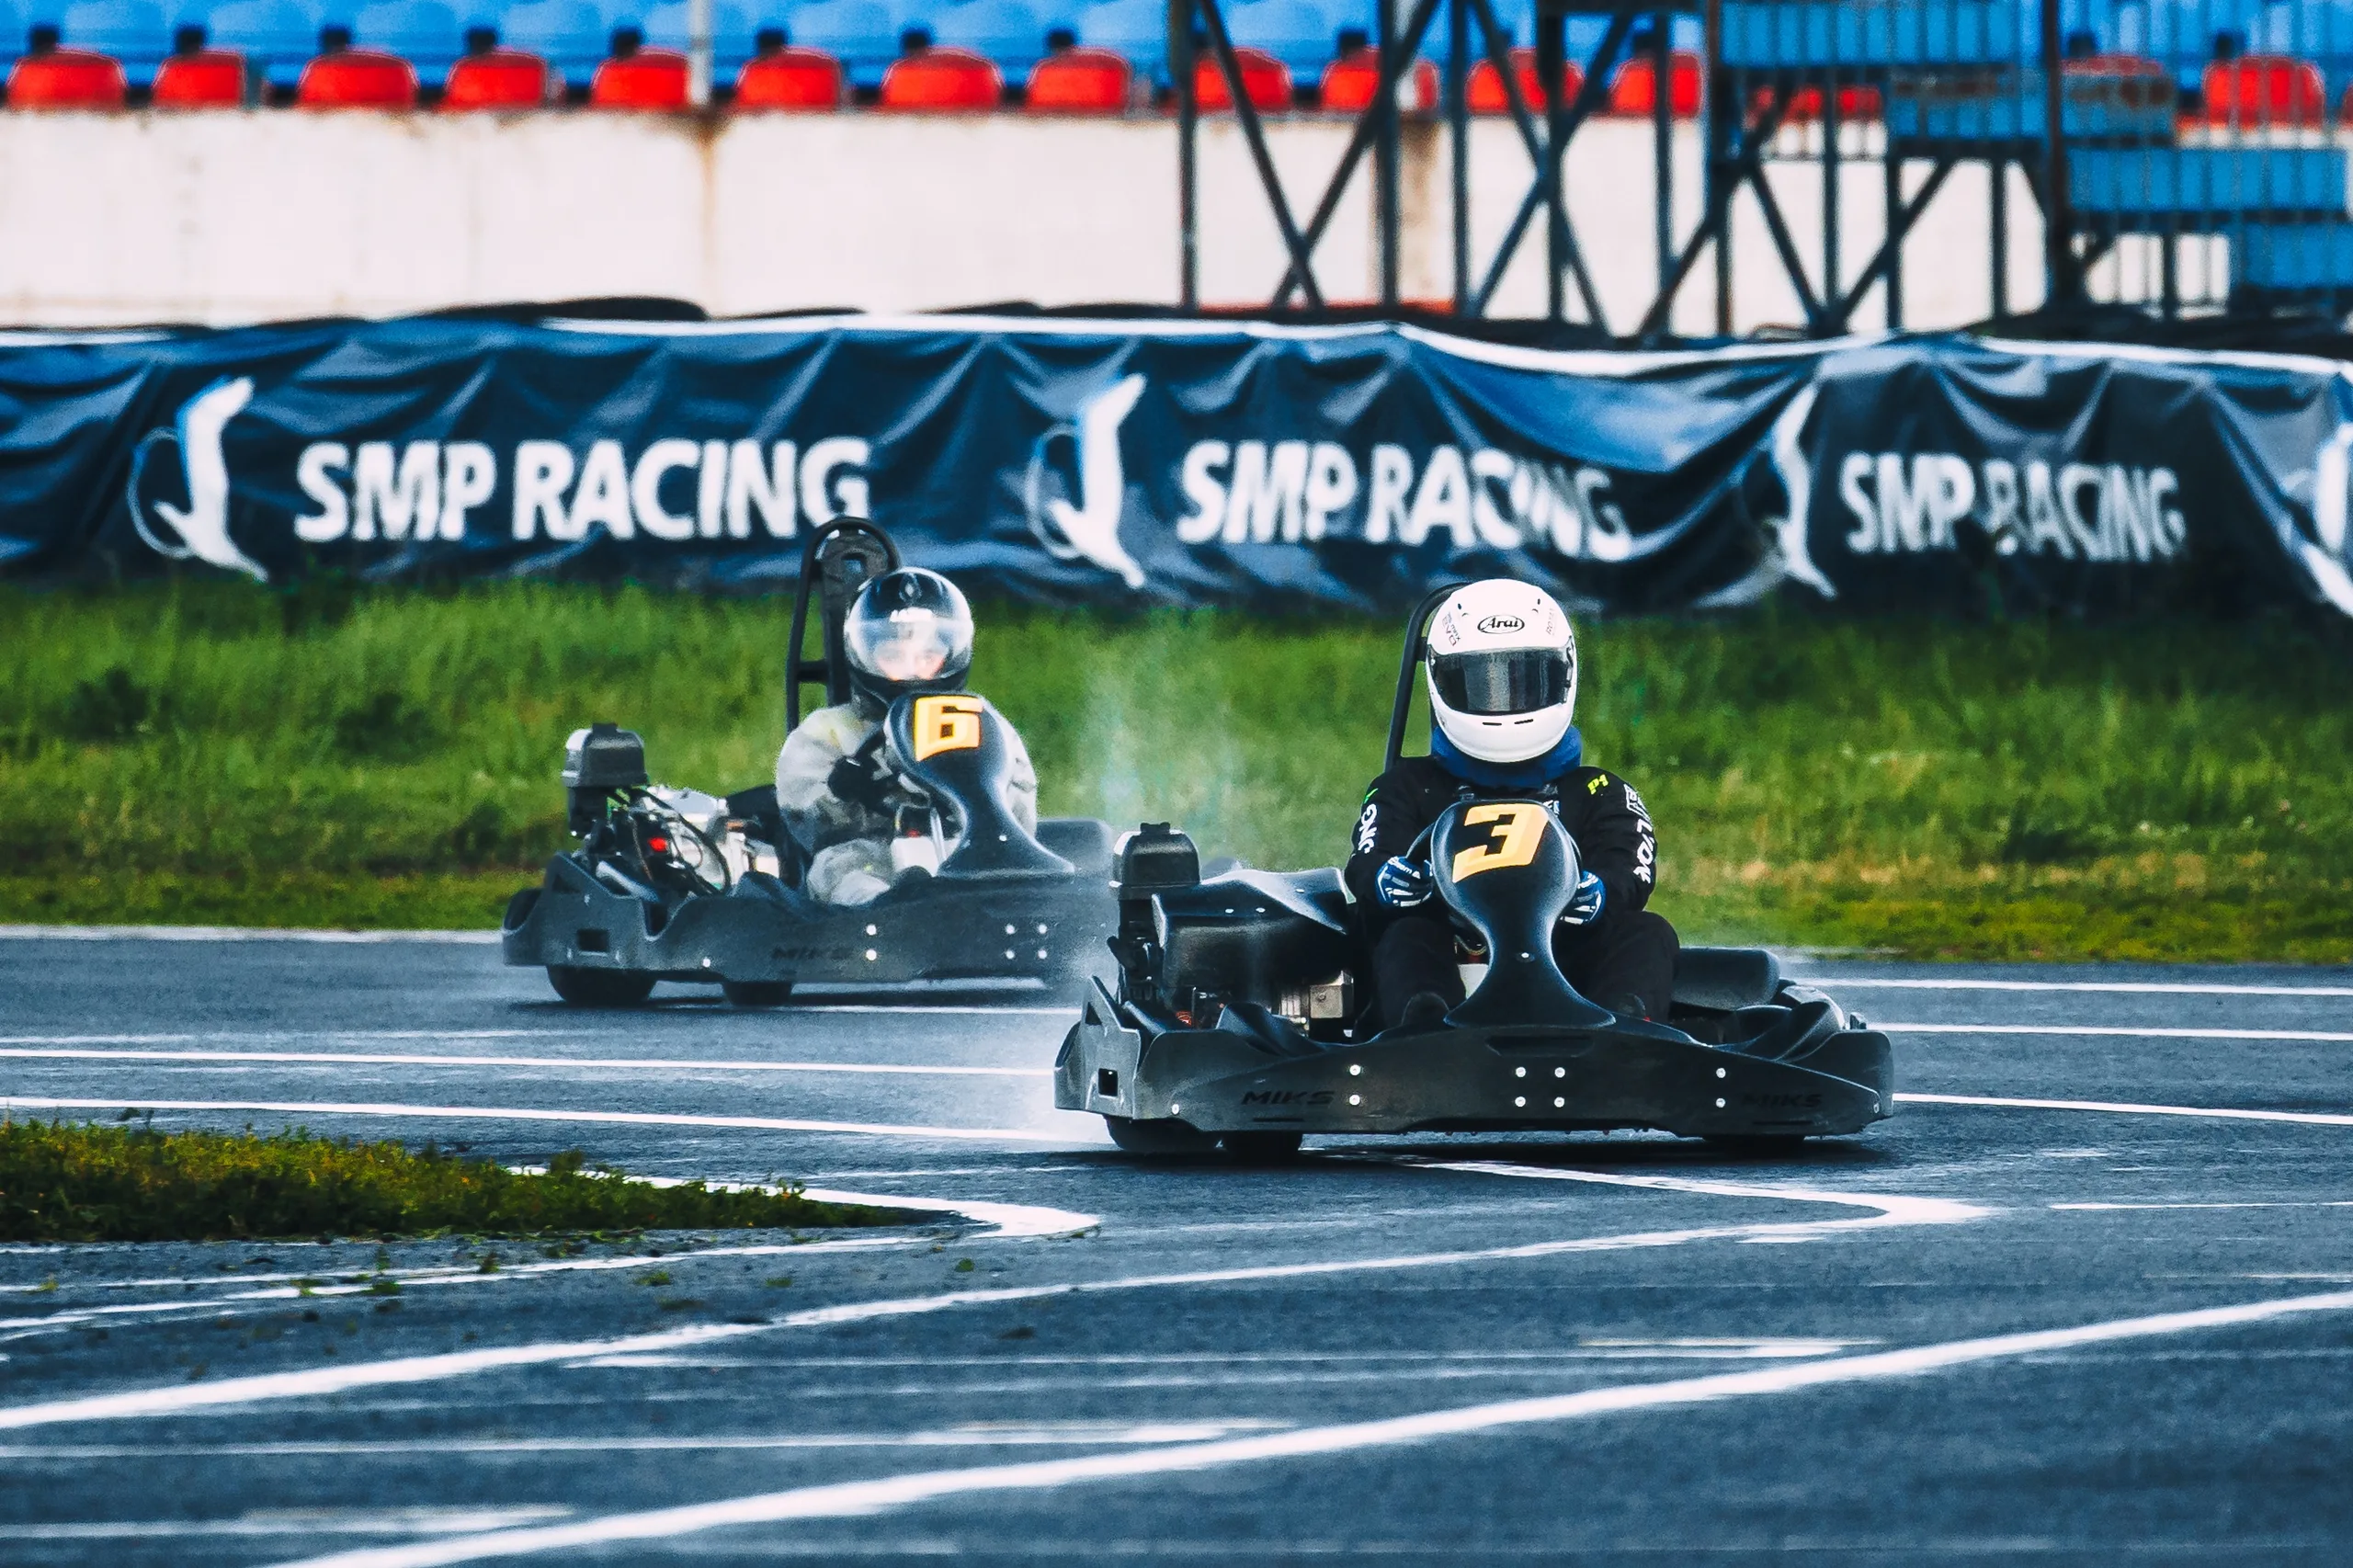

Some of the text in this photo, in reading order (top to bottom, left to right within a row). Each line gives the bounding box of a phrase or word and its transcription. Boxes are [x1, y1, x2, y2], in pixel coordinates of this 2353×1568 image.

[294, 437, 870, 541] SMP RACING
[1177, 439, 1631, 562] SMP RACING
[1841, 452, 1975, 553] SMP
[1481, 616, 1519, 631] Arai
[914, 695, 984, 762] 6
[1452, 802, 1550, 884] 3
[1240, 1090, 1336, 1106] MIKS
